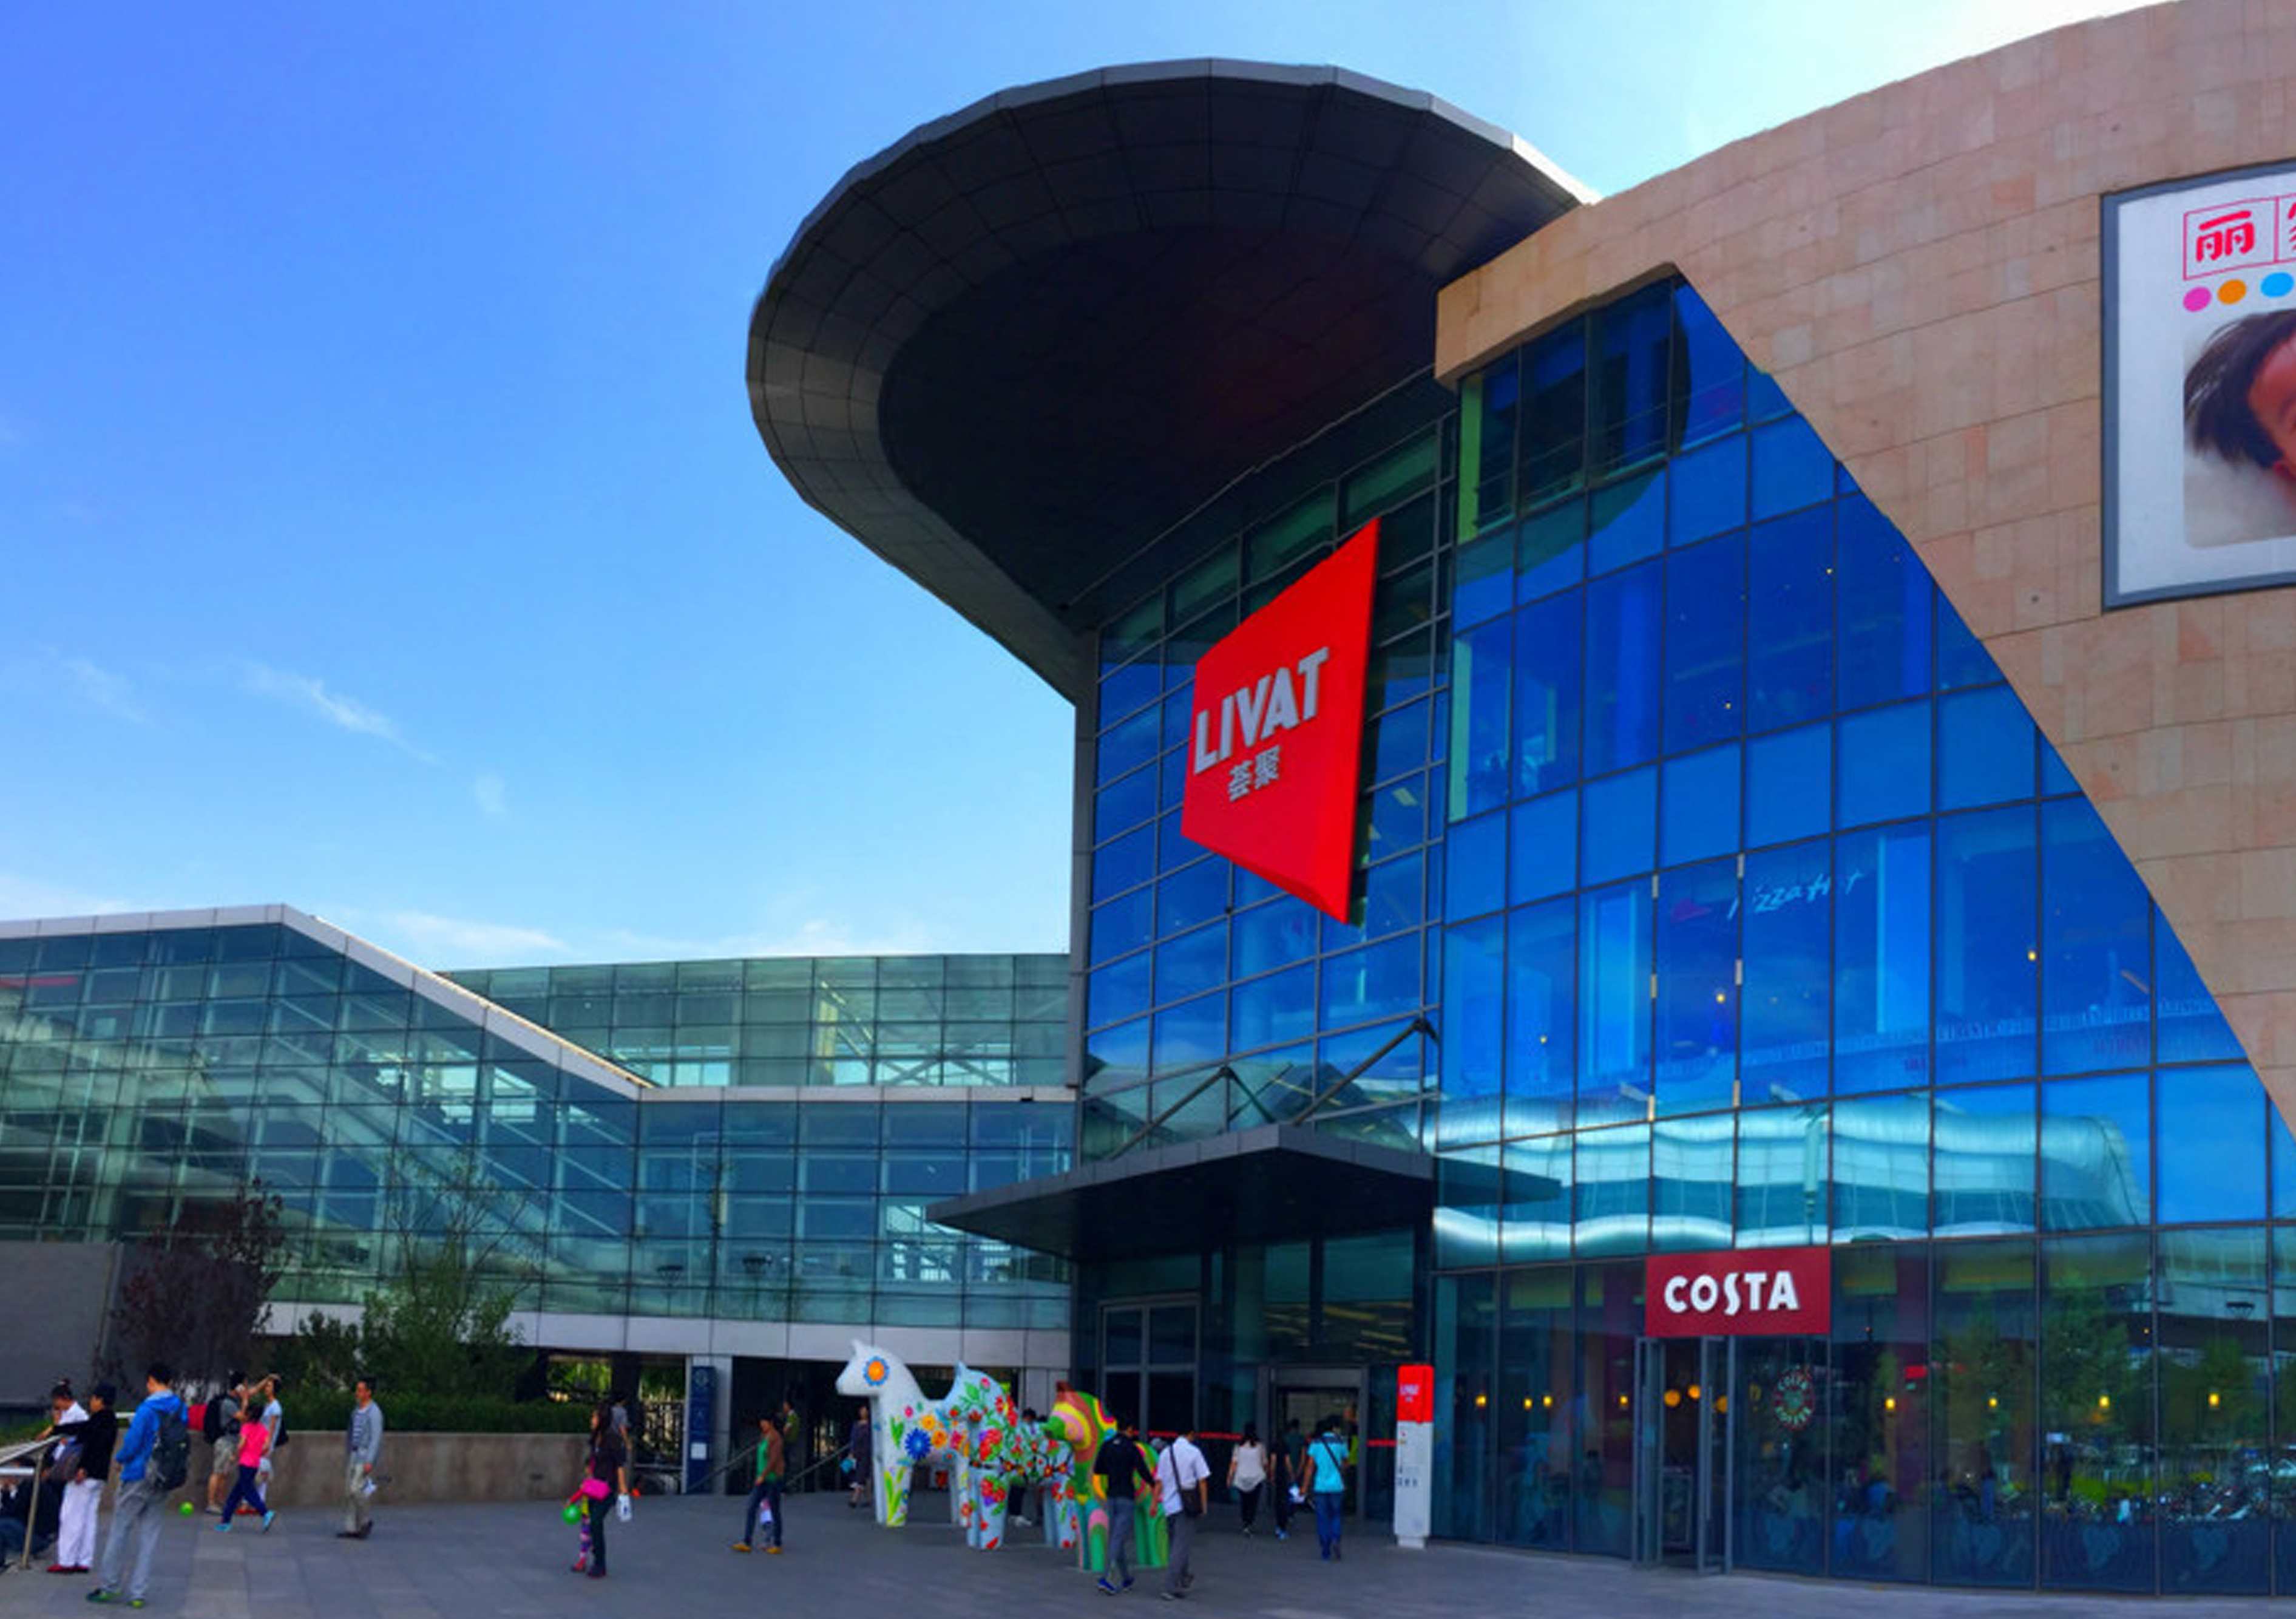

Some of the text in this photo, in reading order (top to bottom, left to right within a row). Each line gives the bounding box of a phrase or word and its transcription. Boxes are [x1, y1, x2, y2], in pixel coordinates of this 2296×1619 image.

[1194, 646, 1329, 775] LIVAT
[1228, 744, 1280, 802] 荟聚
[1664, 1271, 1800, 1316] COSTA
